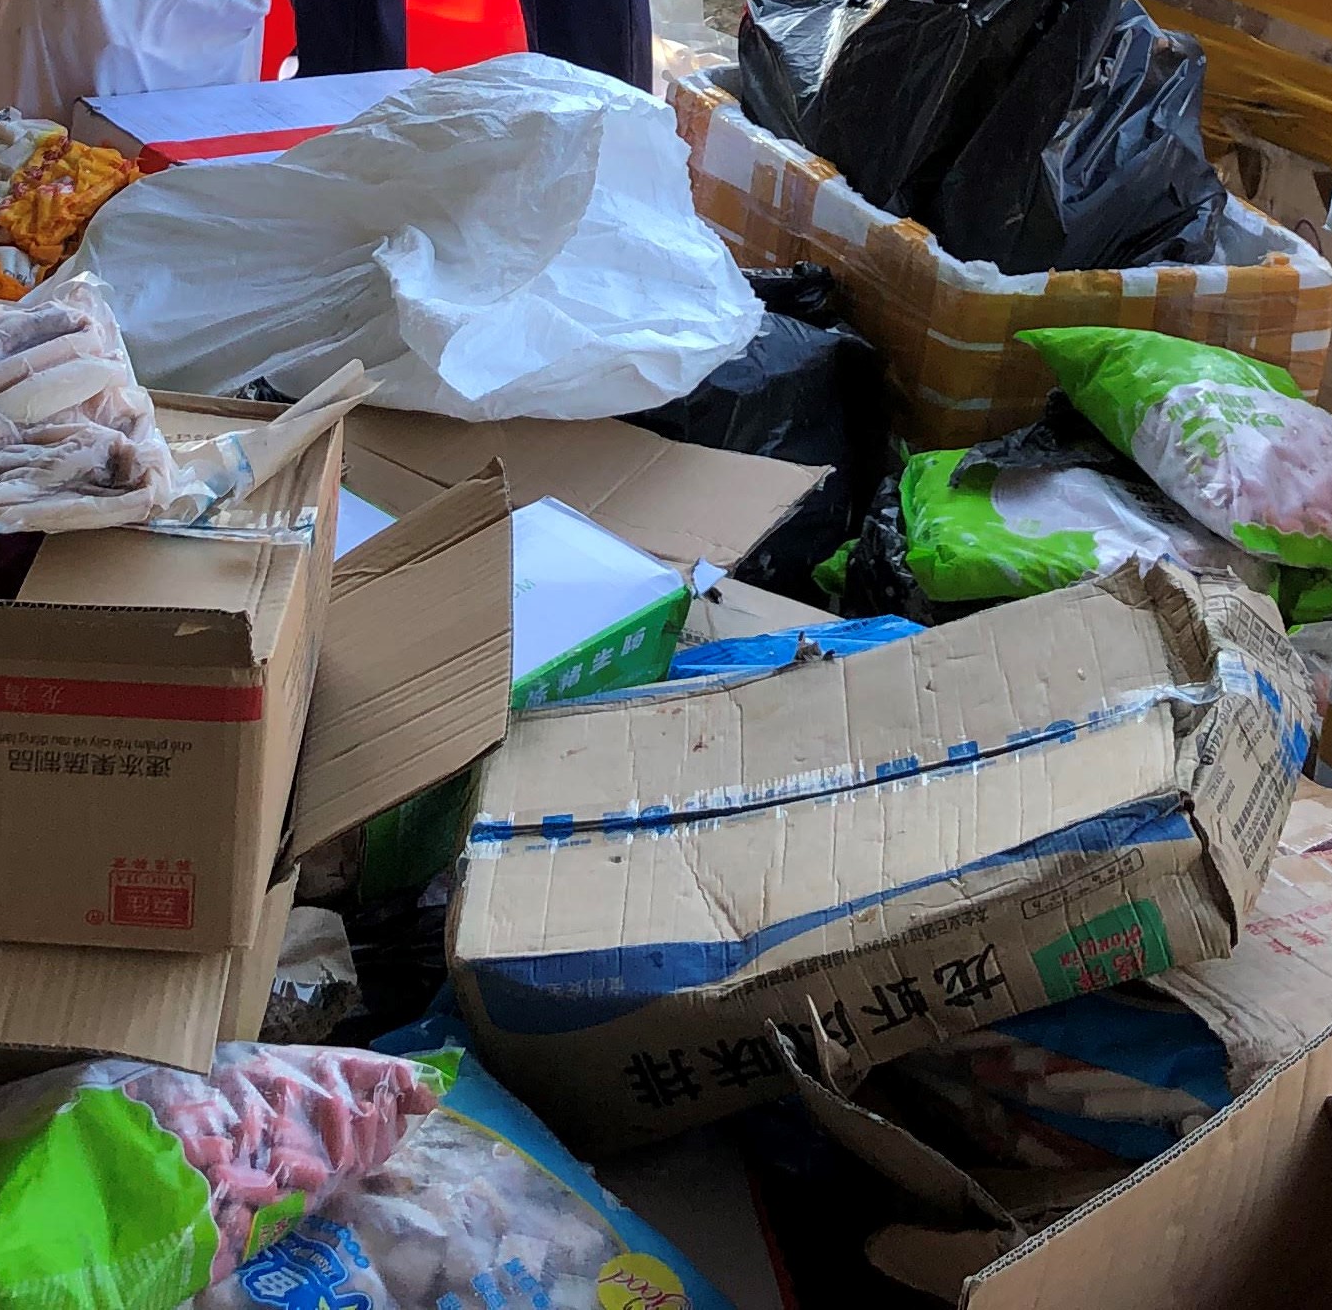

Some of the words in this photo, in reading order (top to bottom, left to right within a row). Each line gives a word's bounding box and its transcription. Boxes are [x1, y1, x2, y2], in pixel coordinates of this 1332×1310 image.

[8, 749, 172, 778] 速冻果蔬制品
